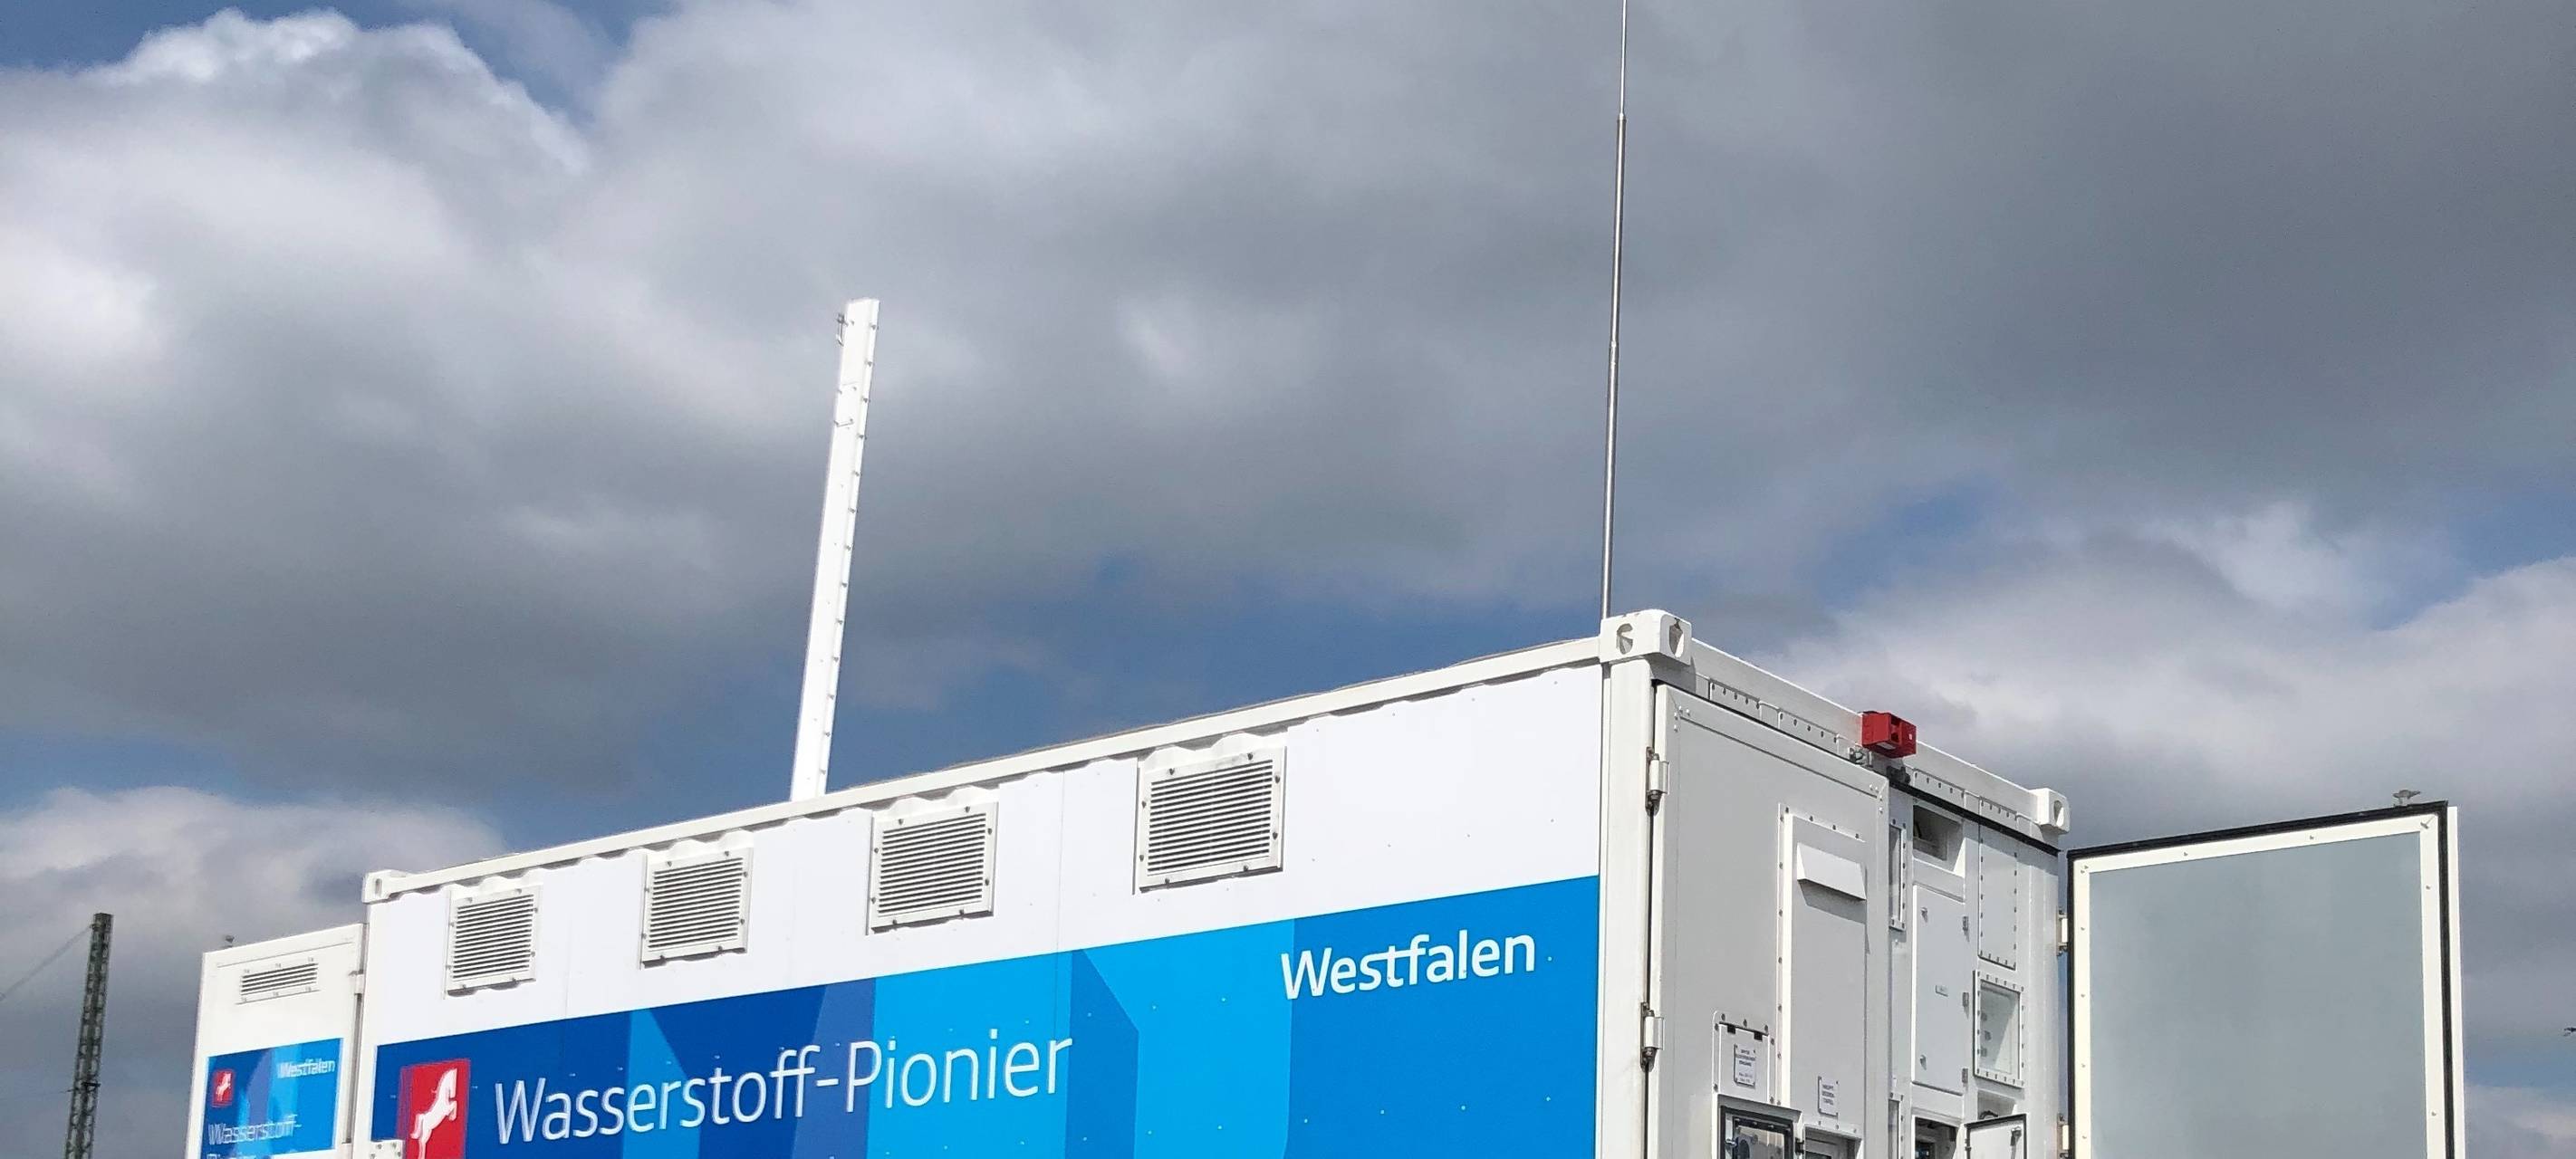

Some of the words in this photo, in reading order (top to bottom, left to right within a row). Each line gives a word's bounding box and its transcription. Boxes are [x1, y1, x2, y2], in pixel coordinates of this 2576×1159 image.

[1281, 930, 1535, 1000] Westfalen
[277, 1058, 335, 1078] Westfalen
[495, 1029, 1073, 1145] Wasserstoff-Pionier
